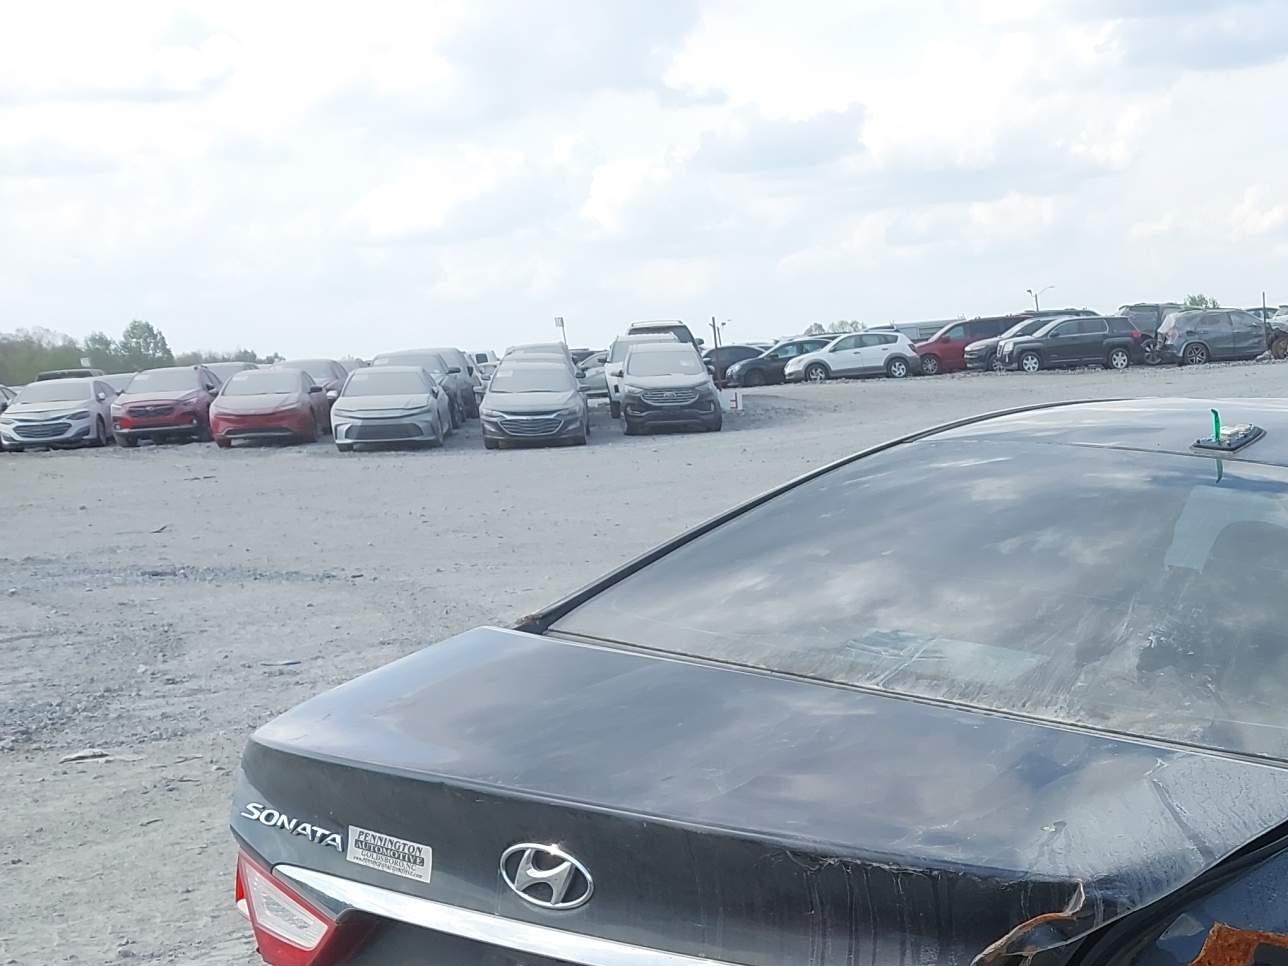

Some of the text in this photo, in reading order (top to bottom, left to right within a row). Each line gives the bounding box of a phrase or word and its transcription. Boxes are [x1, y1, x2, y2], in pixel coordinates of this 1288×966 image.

[240, 802, 343, 853] SONATA
[354, 839, 424, 866] AUTOMOTIVE
[357, 830, 423, 857] PENNINGTON
